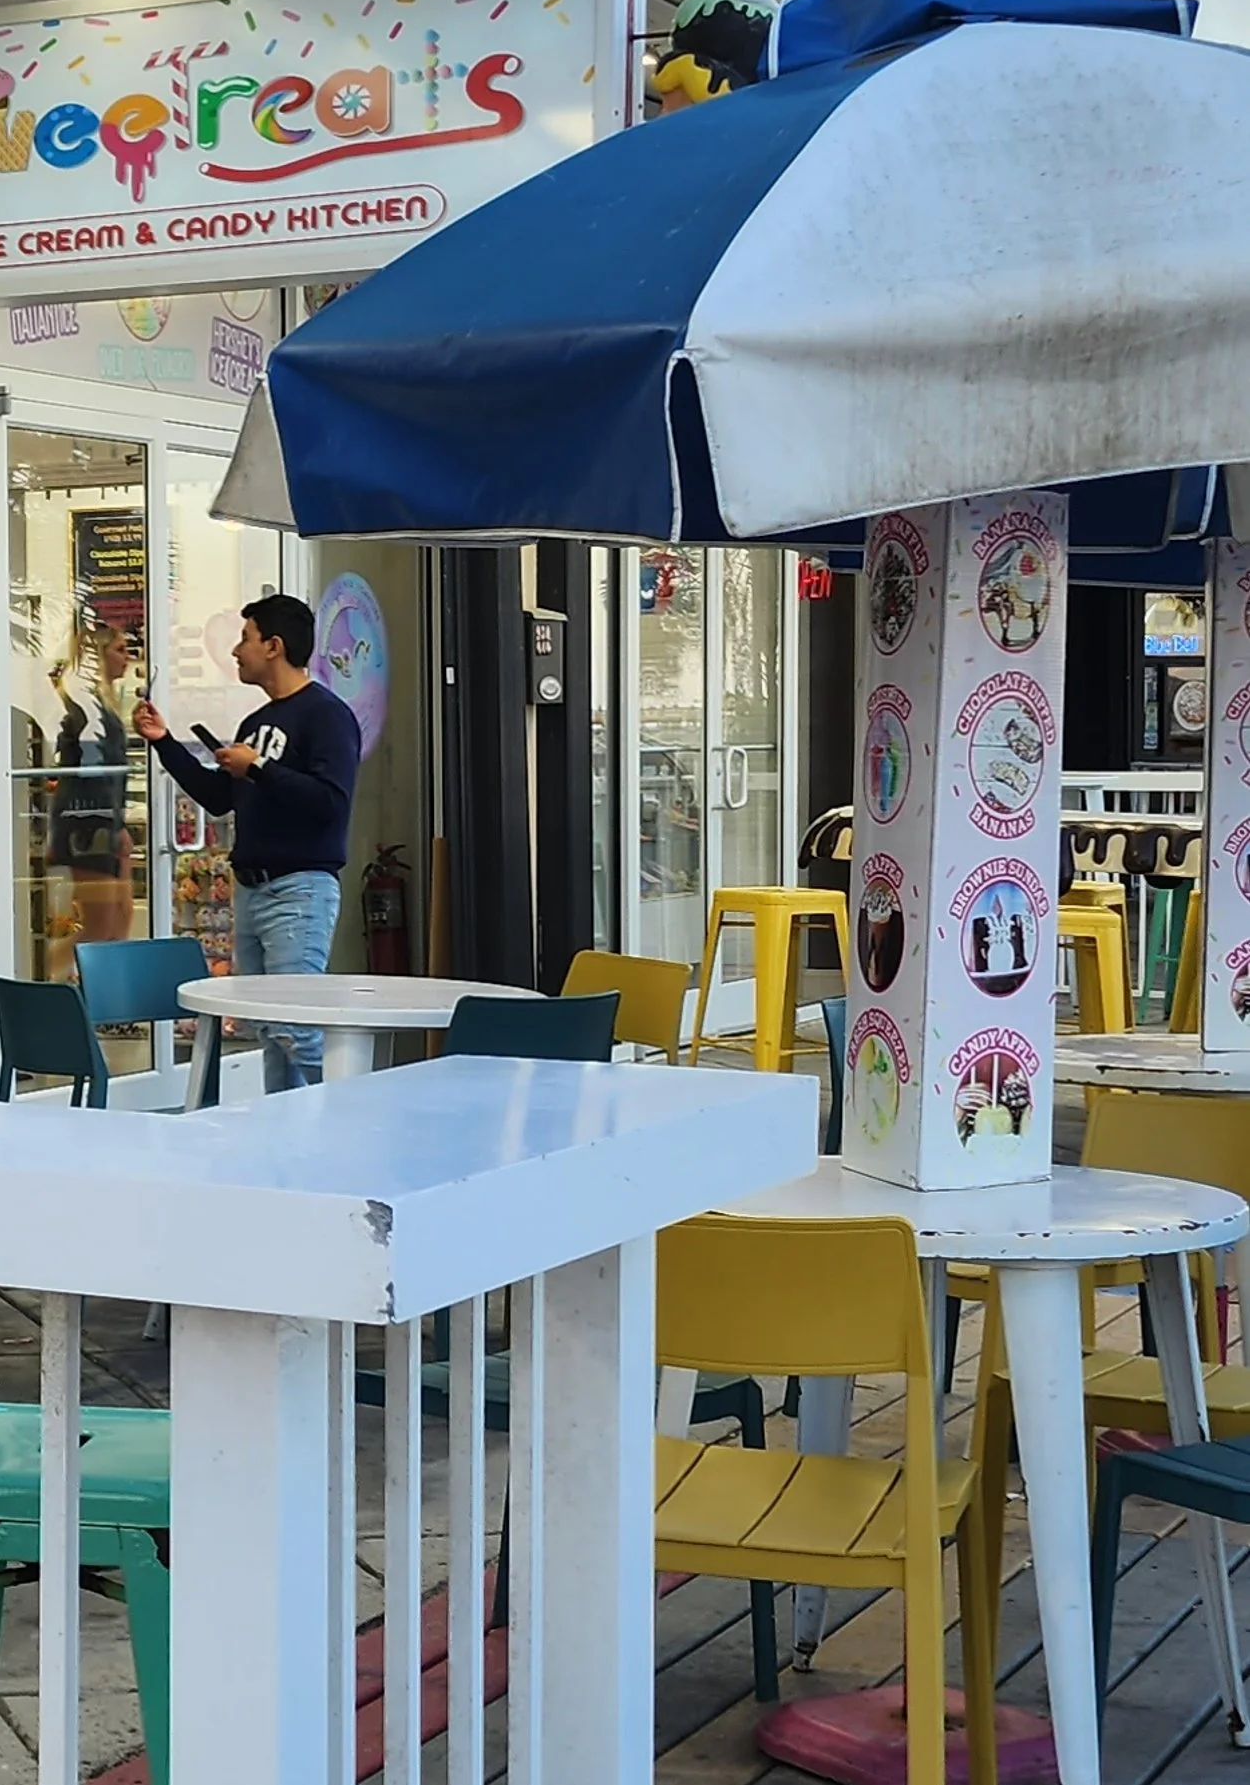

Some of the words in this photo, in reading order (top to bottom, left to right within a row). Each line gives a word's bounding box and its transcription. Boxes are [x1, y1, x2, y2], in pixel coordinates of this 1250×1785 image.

[17, 223, 124, 255] CREAM
[136, 221, 156, 245] &
[167, 210, 276, 242] CANDY
[286, 194, 429, 232] KITCHEN
[11, 305, 56, 344] ITALIAN
[957, 671, 1030, 734] CHOCOLATE
[970, 802, 1036, 839] BANANAS
[951, 858, 1008, 919] BROWNIE
[949, 1029, 999, 1076] CANDY
